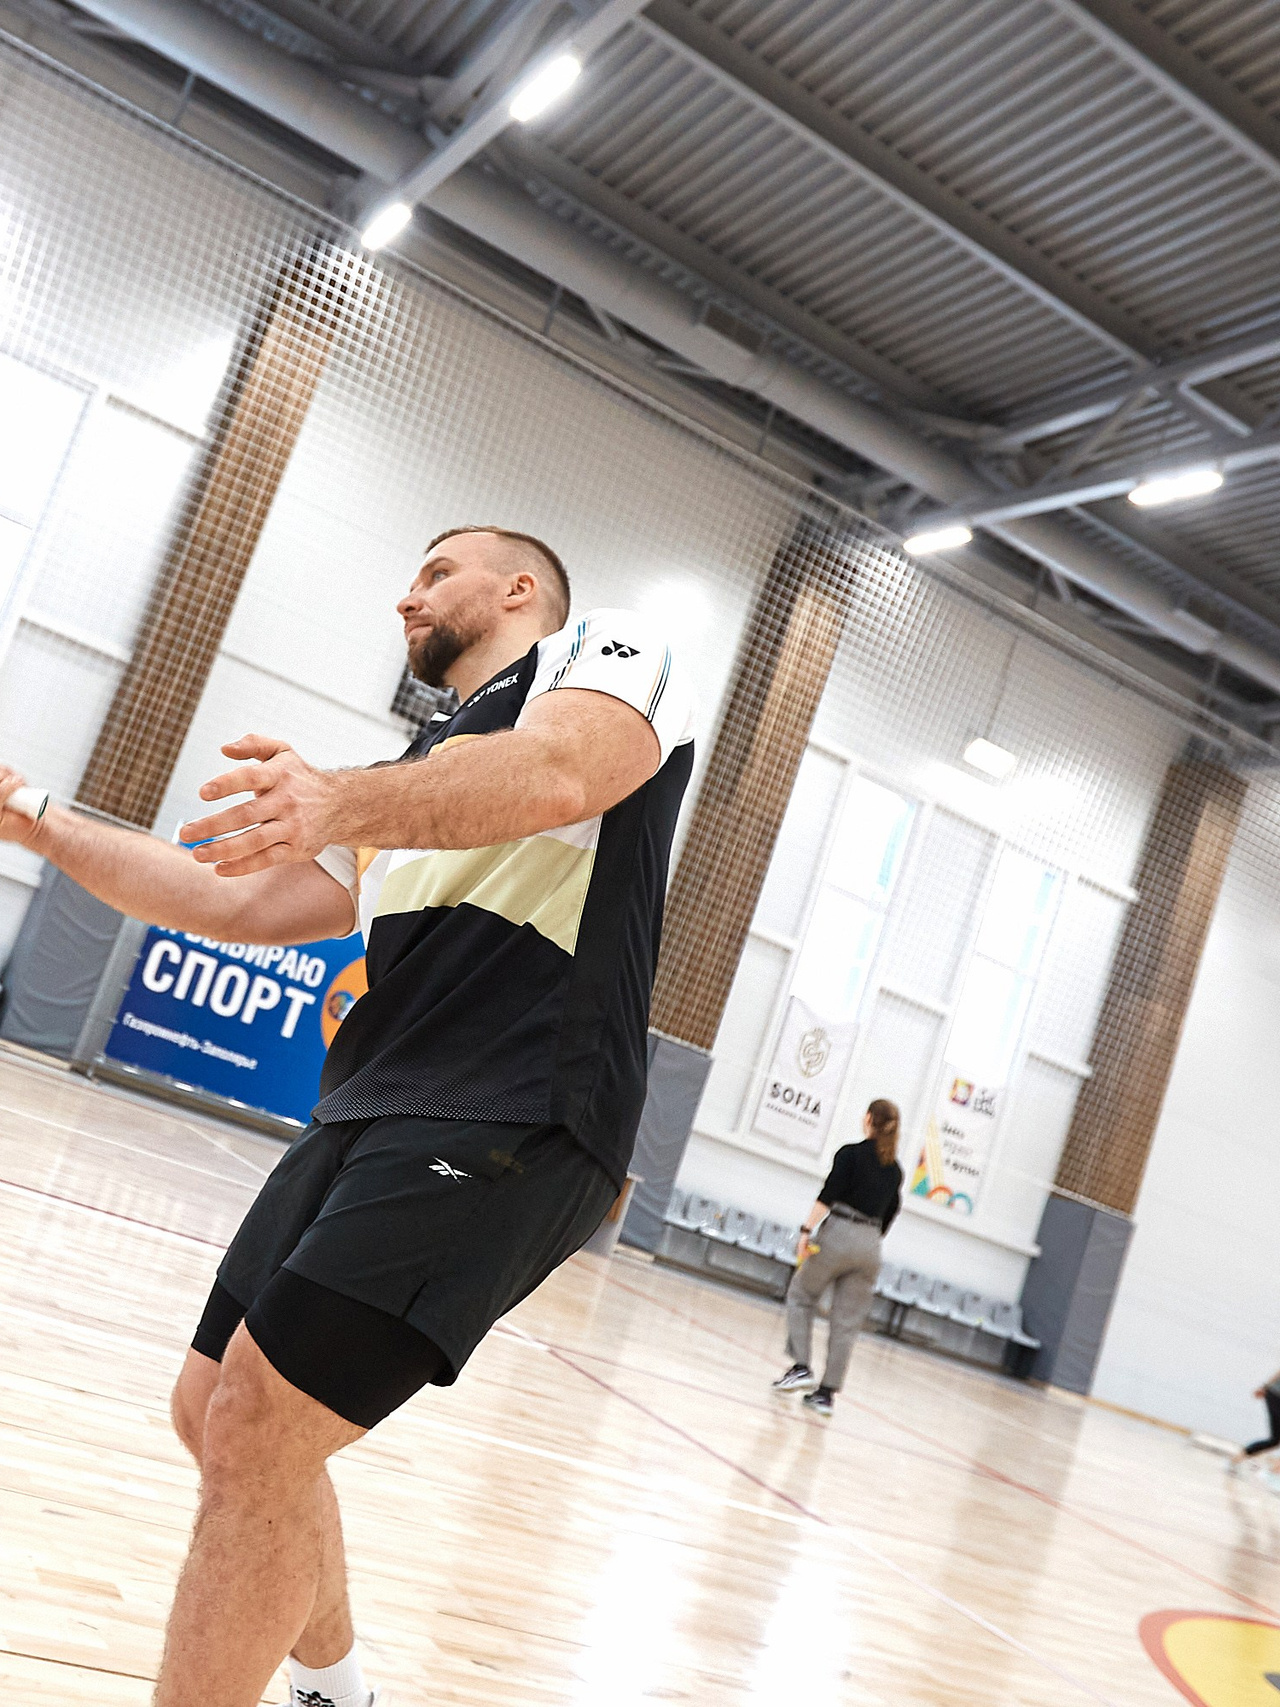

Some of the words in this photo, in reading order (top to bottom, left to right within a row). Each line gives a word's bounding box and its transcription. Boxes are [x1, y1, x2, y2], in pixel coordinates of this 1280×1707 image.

[486, 672, 519, 695] YONEX
[142, 938, 317, 1039] СПОРТ
[770, 1082, 821, 1117] SOFIA
